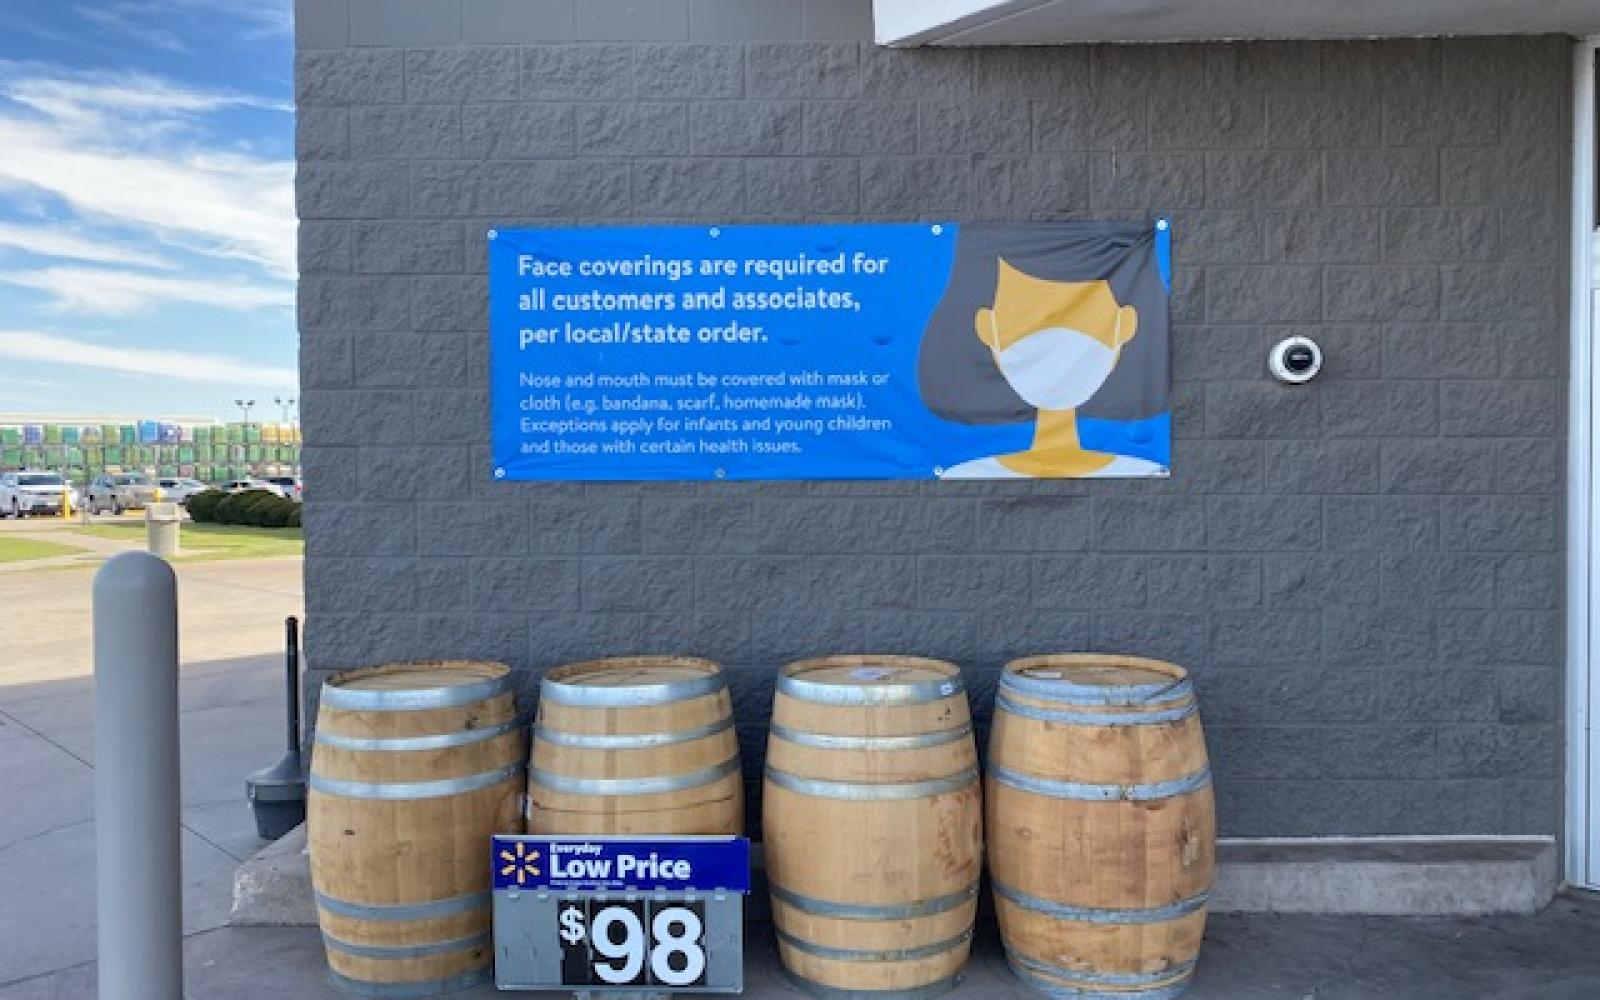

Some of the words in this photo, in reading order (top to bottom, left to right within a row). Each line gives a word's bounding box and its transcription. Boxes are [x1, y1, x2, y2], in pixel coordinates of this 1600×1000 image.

[519, 254, 571, 276] Face
[579, 255, 693, 281] coverings
[700, 259, 738, 276] are
[744, 253, 846, 280] required
[853, 252, 889, 274] for
[519, 288, 546, 311] all
[552, 289, 676, 311] customers
[682, 287, 726, 309] and
[732, 286, 861, 312] associates,
[519, 325, 558, 350] per
[564, 322, 691, 344] local/state
[697, 321, 768, 343] order.
[520, 373, 562, 388] Nose
[565, 373, 595, 387] and
[598, 372, 651, 387] mouth
[654, 373, 694, 387] must
[697, 372, 718, 387] be
[721, 371, 786, 387] covered
[789, 371, 824, 385] with
[827, 371, 868, 385] mask
[872, 373, 890, 385] or
[520, 395, 561, 411] cloth
[724, 393, 811, 410] homemade
[520, 418, 607, 434] Exceptions
[611, 418, 652, 434] apply
[657, 417, 681, 431] for
[684, 417, 738, 431] infants
[742, 417, 771, 431] and
[774, 417, 823, 434] young
[827, 416, 892, 431] children
[520, 440, 550, 454] and
[554, 440, 598, 454] those
[602, 439, 635, 453] with
[639, 439, 695, 453] certain
[700, 439, 749, 453] health
[752, 439, 803, 453] issues.
[550, 842, 603, 855] Everyday
[550, 854, 612, 878] Low
[617, 853, 691, 878] Price
